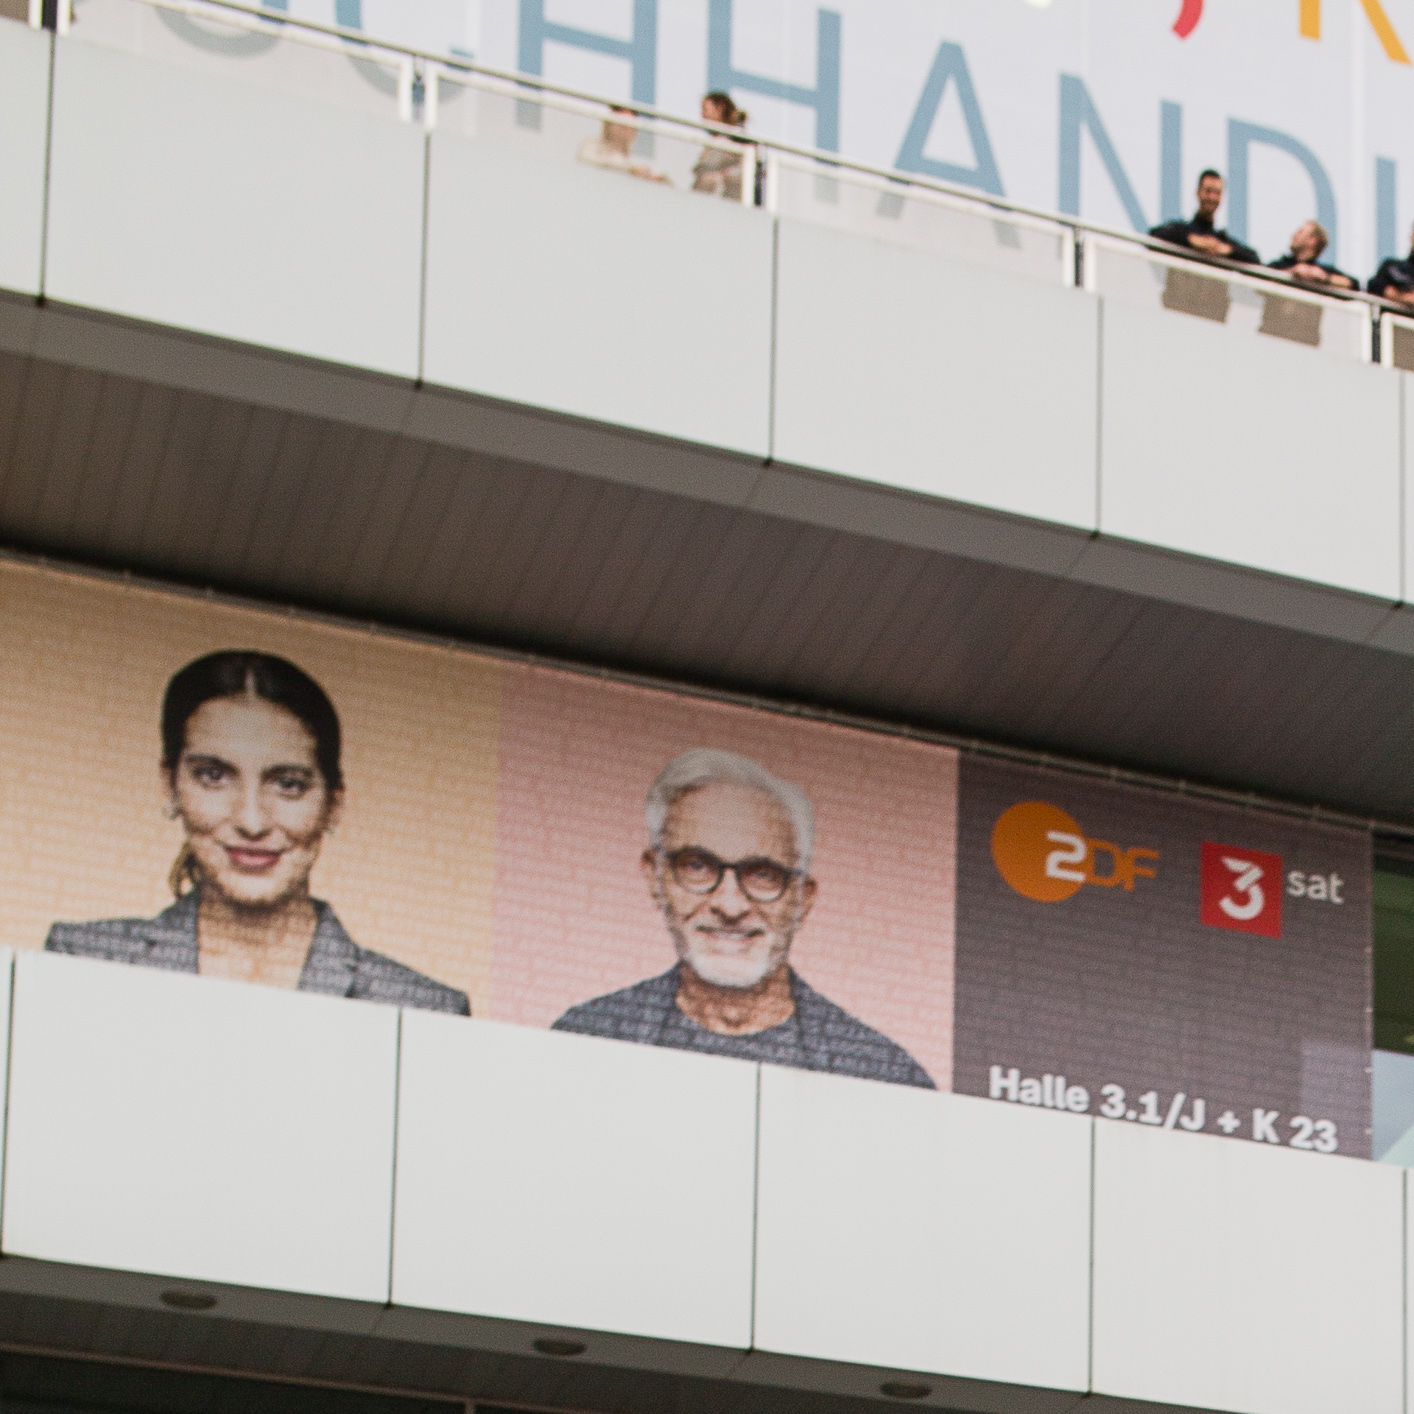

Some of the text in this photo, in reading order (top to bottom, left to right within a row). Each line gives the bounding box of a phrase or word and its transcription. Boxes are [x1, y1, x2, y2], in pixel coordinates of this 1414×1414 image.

[990, 1065, 1339, 1154] Halle 3.1/J + K 23
